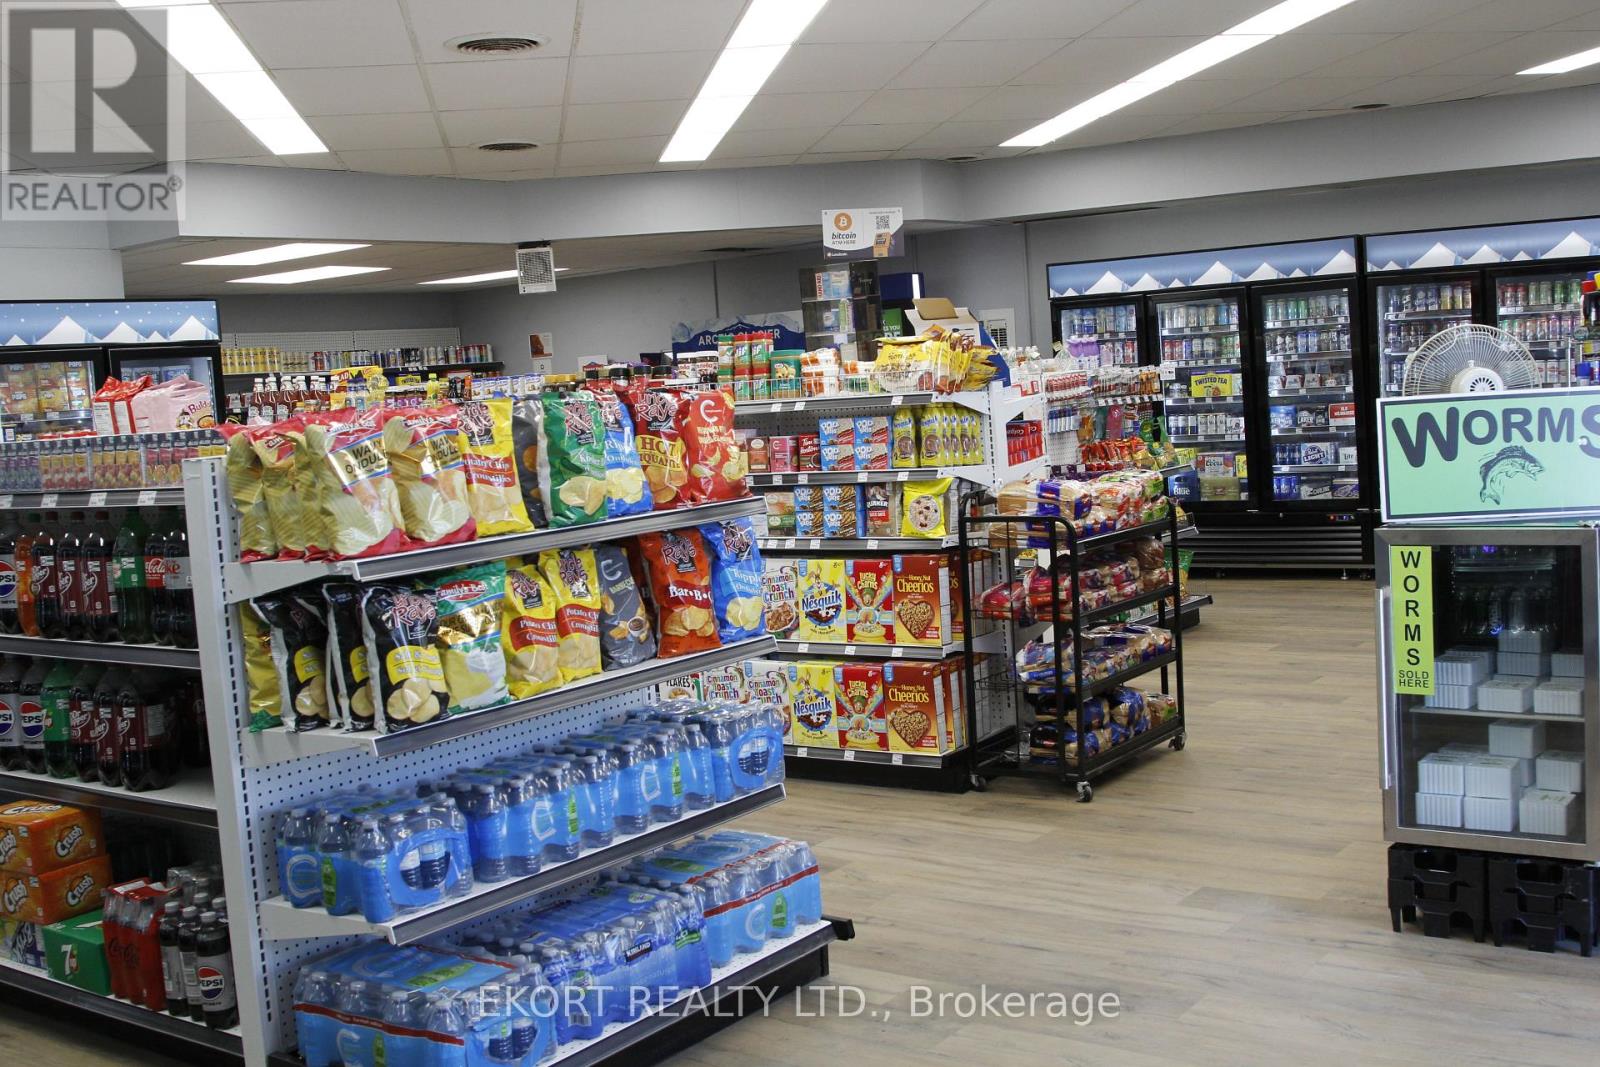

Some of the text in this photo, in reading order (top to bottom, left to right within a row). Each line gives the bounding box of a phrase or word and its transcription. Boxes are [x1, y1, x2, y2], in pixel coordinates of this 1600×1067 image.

[831, 231, 857, 240] bitcoin
[1194, 376, 1228, 386] TWISTED TEA
[1173, 486, 1191, 496] Blue
[761, 575, 794, 585] Cinnamon
[896, 579, 934, 593] Cheerios
[763, 589, 795, 601] Crunch
[801, 592, 842, 611] Nesquik
[1400, 550, 1422, 666] WORMS
[1398, 669, 1429, 680] SOLD
[1399, 679, 1430, 689] HERE
[888, 688, 929, 703] Cheerios
[793, 699, 832, 716] Nesquik
[56, 825, 85, 858] Crush
[4, 879, 29, 913] Crush
[67, 875, 95, 907] Crush
